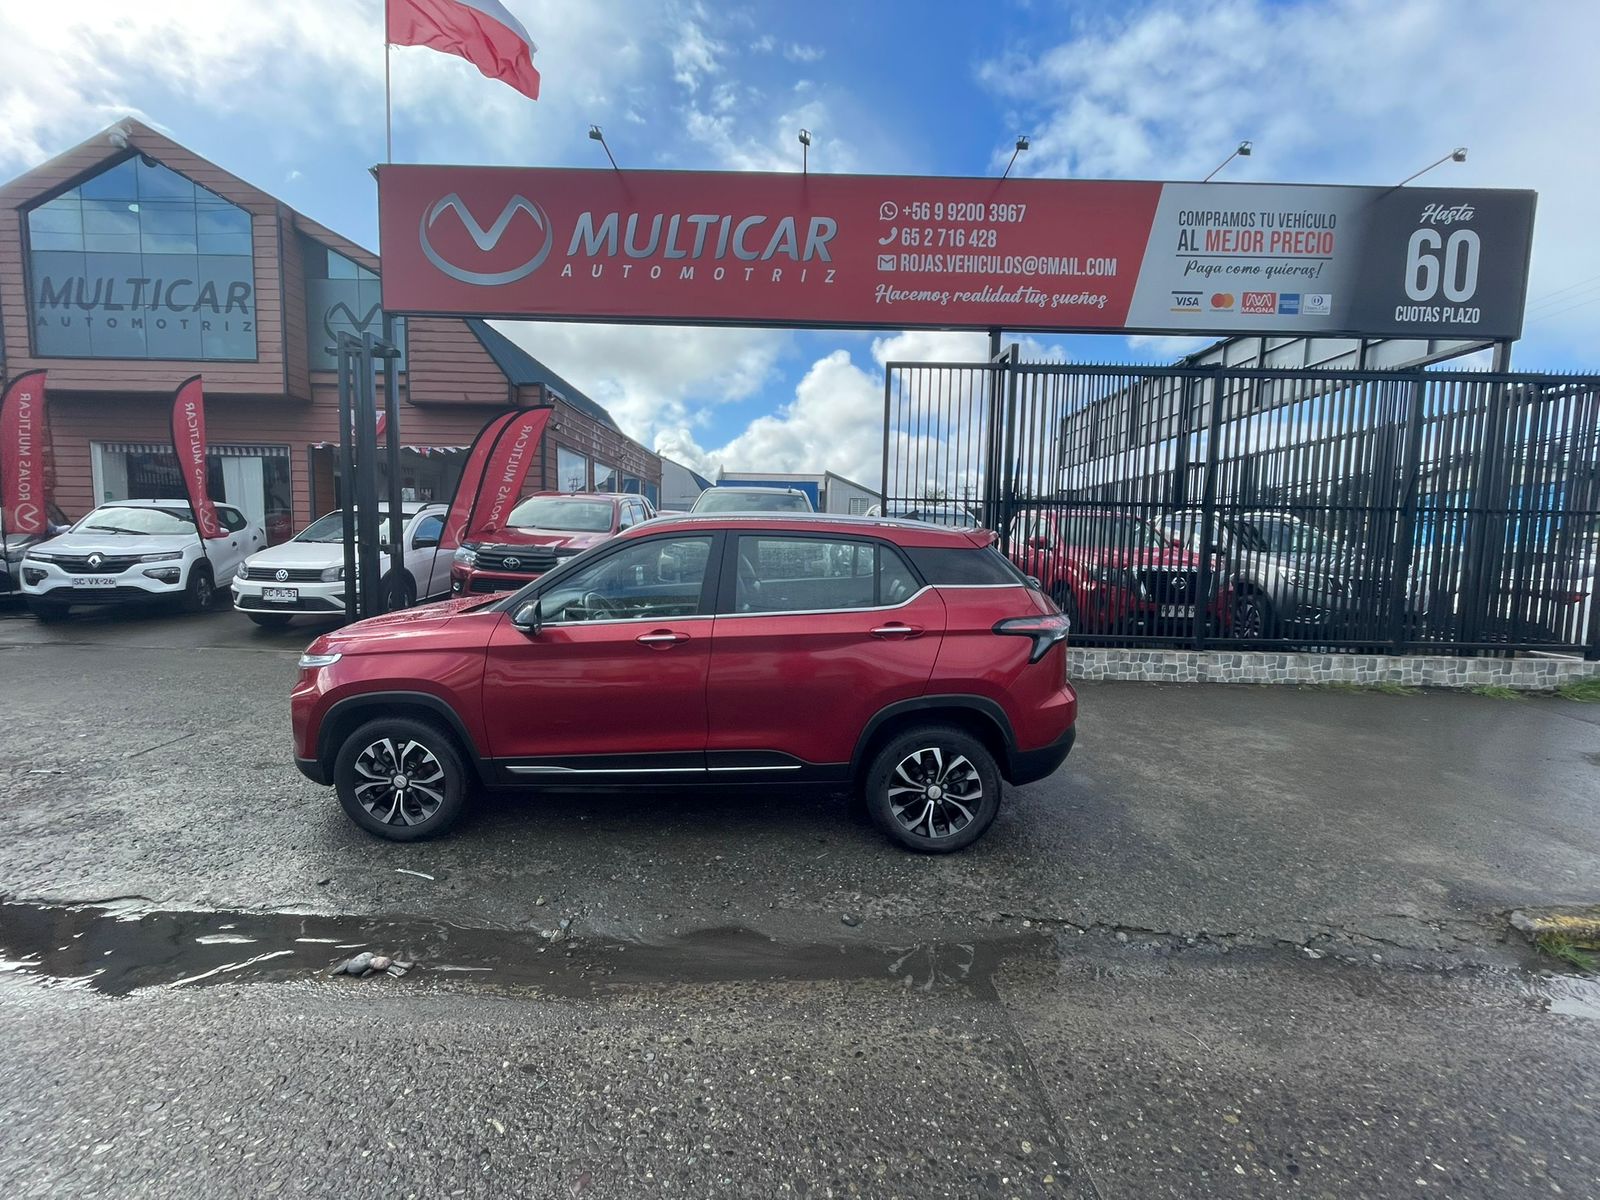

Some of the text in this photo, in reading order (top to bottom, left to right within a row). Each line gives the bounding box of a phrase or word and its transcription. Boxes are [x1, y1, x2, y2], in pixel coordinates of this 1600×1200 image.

[902, 202, 1027, 223] +56 9 9200 3967
[1178, 210, 1337, 229] COMPRAMOS TU VEHÍCULO
[1420, 203, 1475, 225] Hasta
[566, 211, 838, 262] MULTICAR
[901, 227, 920, 246] 65
[924, 228, 933, 247] 2
[968, 229, 997, 248] 428
[1177, 229, 1334, 254] AL MEJOR PRECIO
[561, 263, 837, 284] AUTOMOTRIZ
[900, 254, 1117, 277] ROJAS.VEHICULOS@GMAIL.COM
[1184, 260, 1324, 279] Paga como quieras!
[1405, 228, 1480, 303] 60
[39, 276, 252, 316] MULTICAR
[875, 284, 1108, 308] Hacemos realidad tus sueños
[1176, 297, 1199, 306] VISA
[37, 316, 252, 332] AUTOMOTRIZ
[1395, 306, 1480, 324] CUOTAS PLAZO
